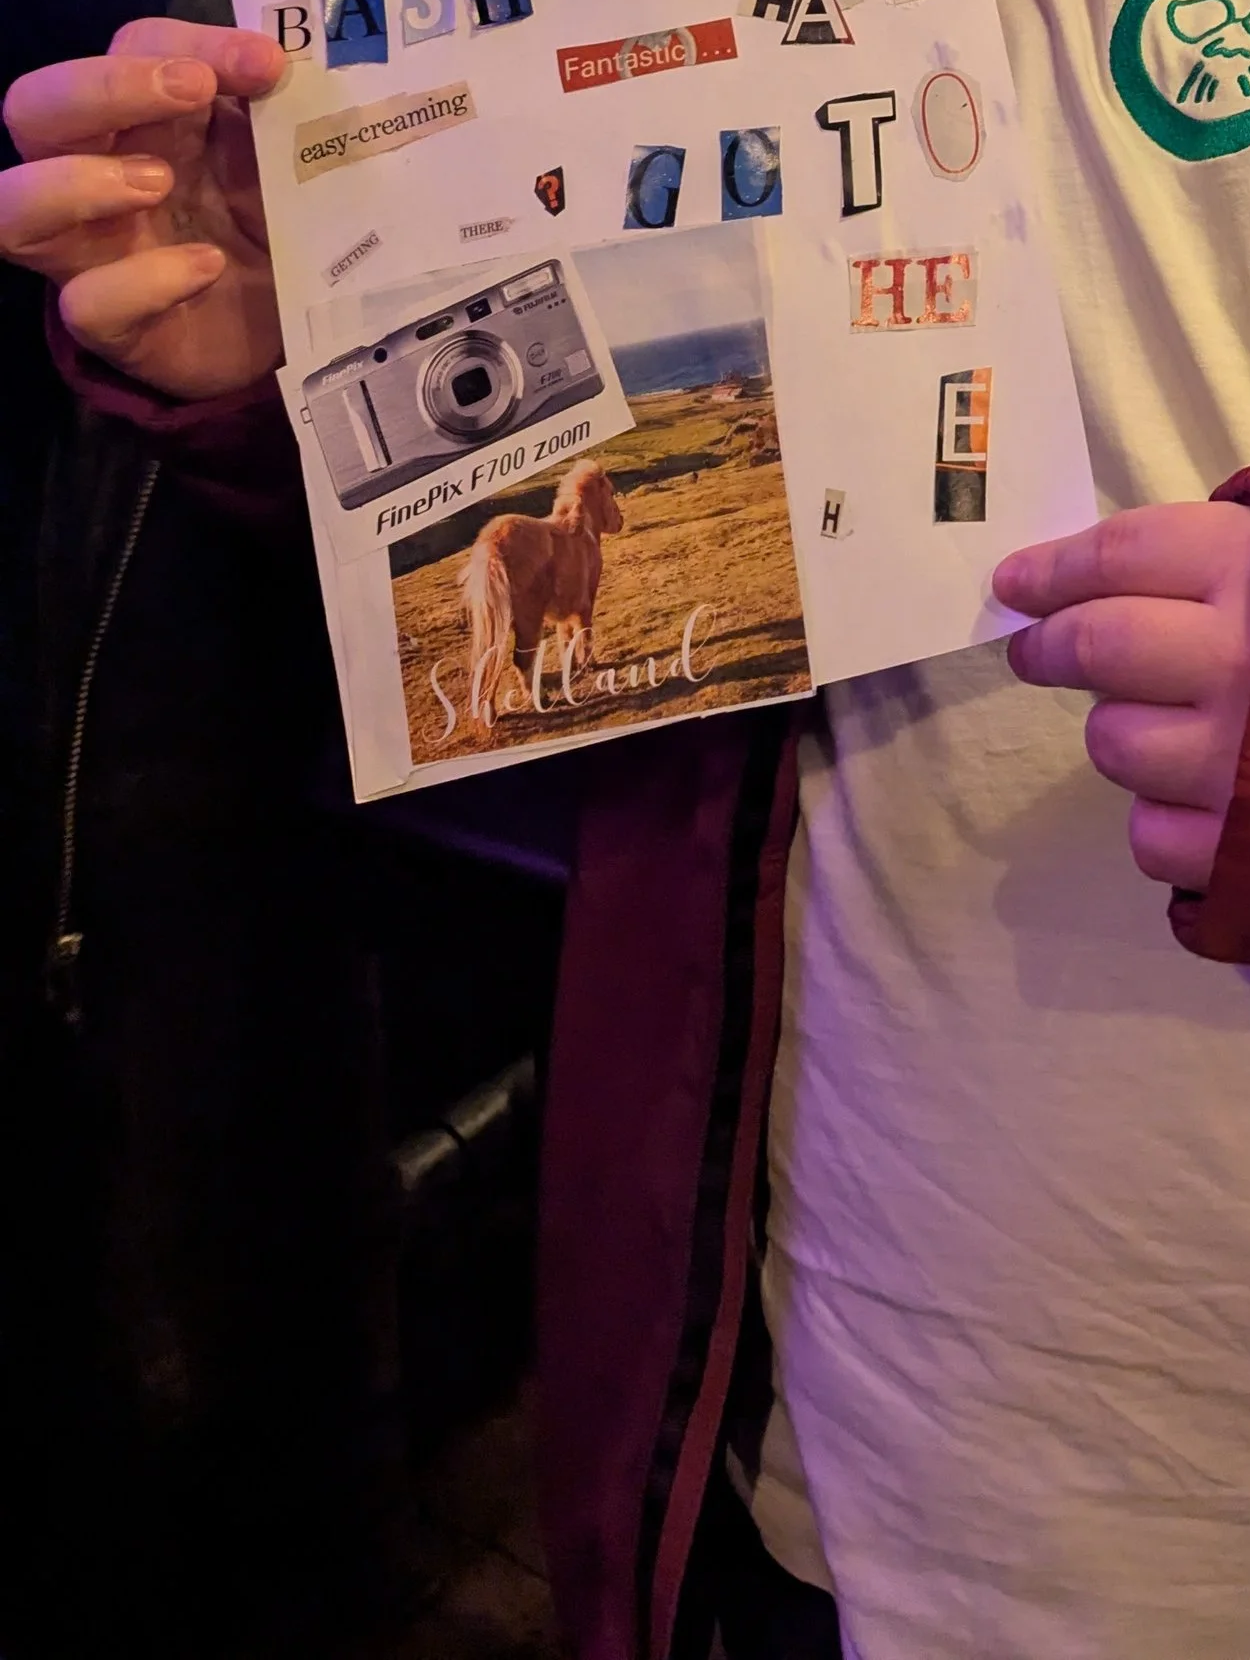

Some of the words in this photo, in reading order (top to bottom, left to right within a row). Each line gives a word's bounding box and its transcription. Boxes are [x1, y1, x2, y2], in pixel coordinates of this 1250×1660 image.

[300, 92, 469, 165] easy-creaming
[331, 233, 380, 278] GETTING
[460, 221, 504, 238] THERE
[852, 253, 970, 327] HE
[942, 383, 986, 461] E
[376, 476, 463, 535] FinePix
[470, 446, 525, 494] F700
[823, 500, 841, 533] H
